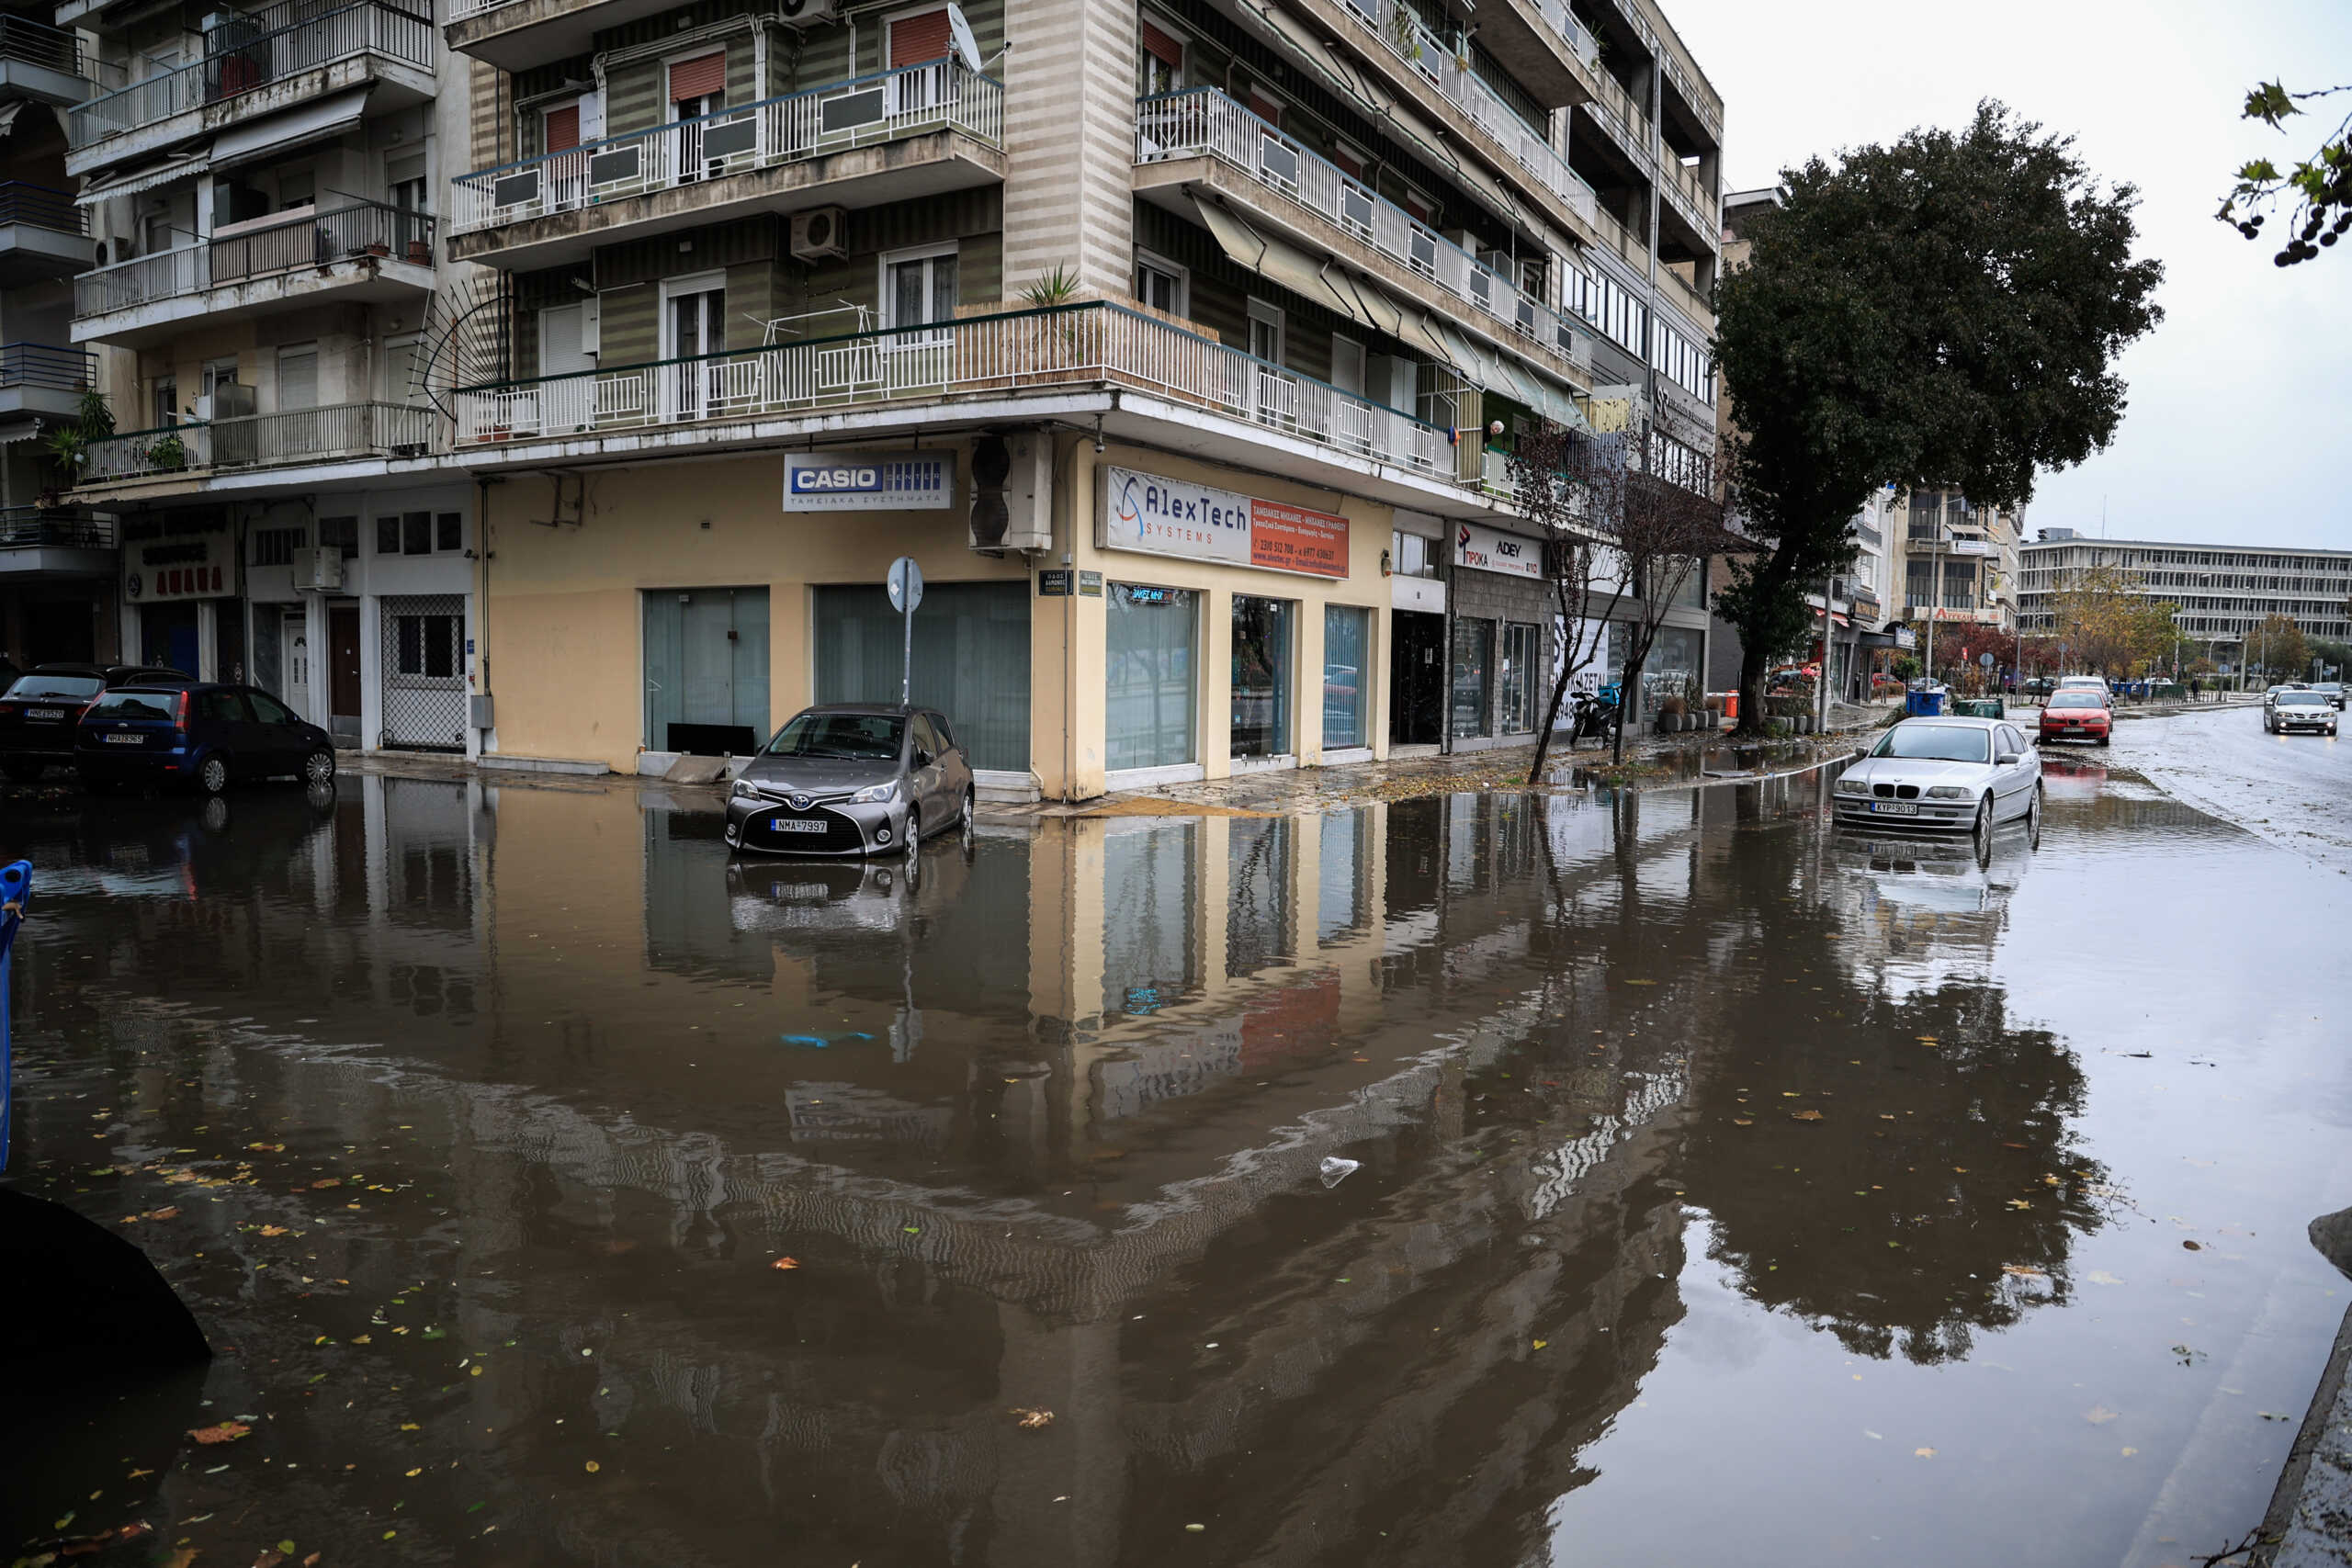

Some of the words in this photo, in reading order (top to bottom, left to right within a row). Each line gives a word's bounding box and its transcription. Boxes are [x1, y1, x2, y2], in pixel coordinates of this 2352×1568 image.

[797, 468, 876, 489] CASIO
[864, 494, 941, 503] ΣΥΣΤΗΜΑΤΑ
[1146, 485, 1247, 531] AlexTech
[1146, 523, 1213, 544] SYSTEMS
[1465, 550, 1488, 567] ΠΡΟΚΑ
[1496, 540, 1521, 558] ADEY
